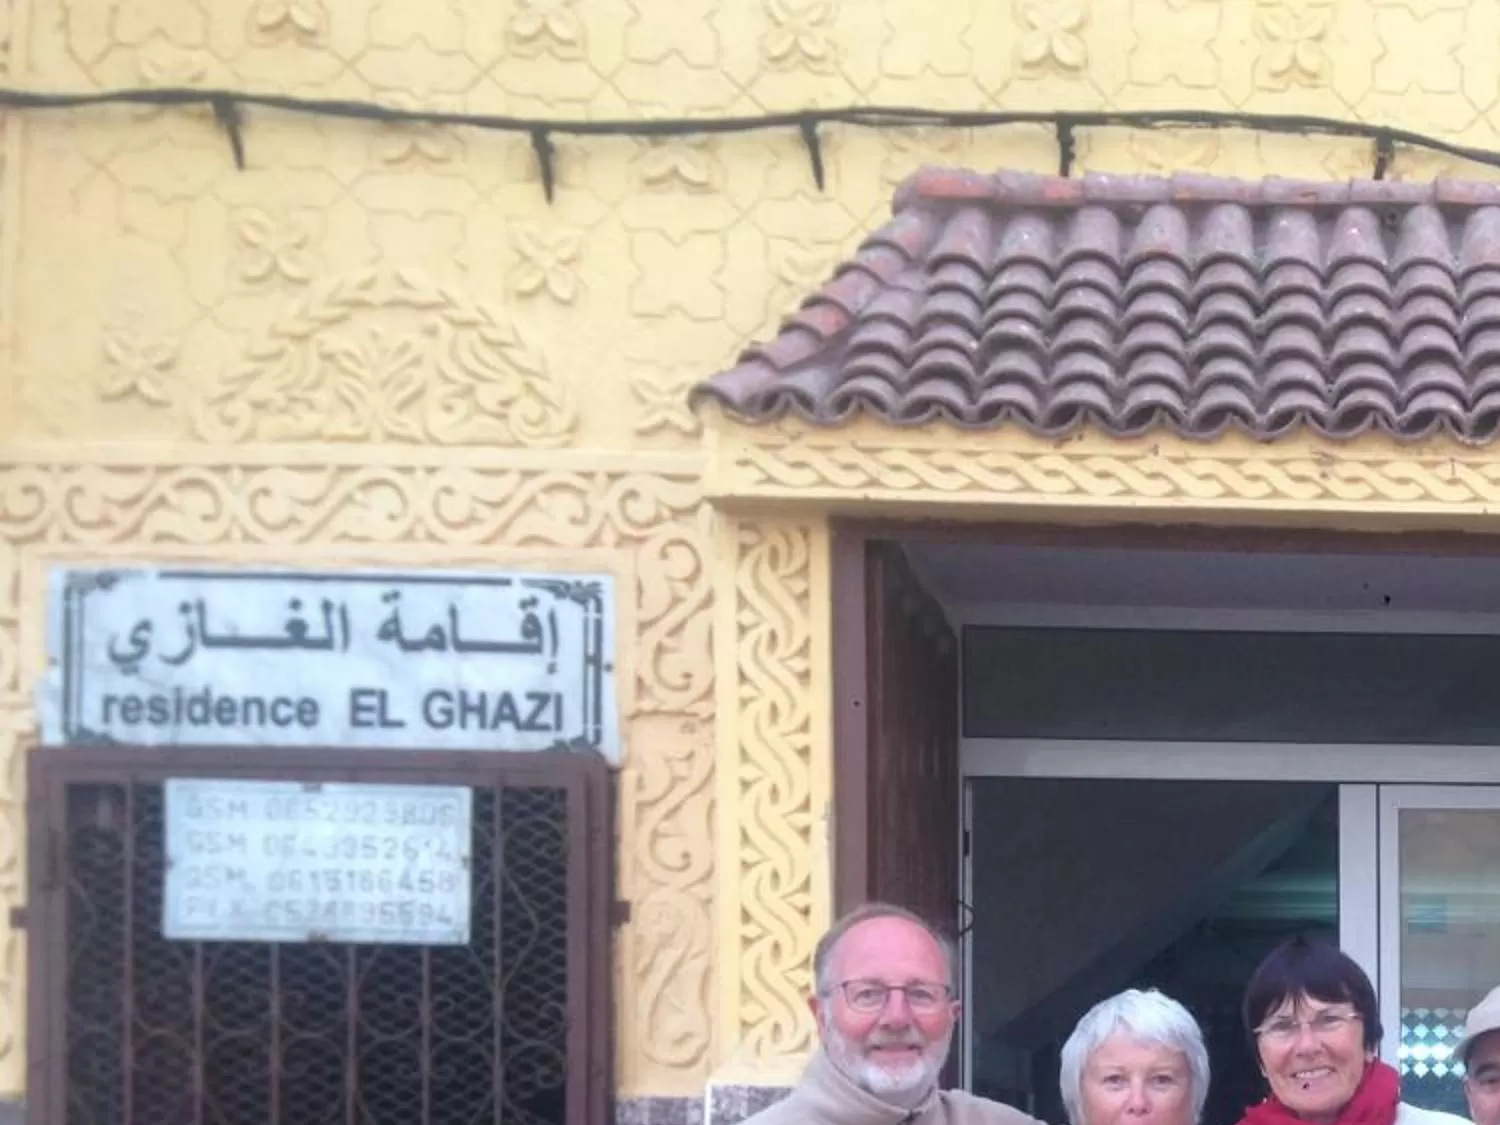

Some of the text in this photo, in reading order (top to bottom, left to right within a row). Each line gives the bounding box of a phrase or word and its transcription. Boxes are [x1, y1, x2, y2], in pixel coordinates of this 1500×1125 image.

[102, 684, 563, 732] residence EL GHAZI
[185, 795, 249, 821] GSM
[185, 830, 249, 856] GSM
[185, 864, 249, 891] GSM
